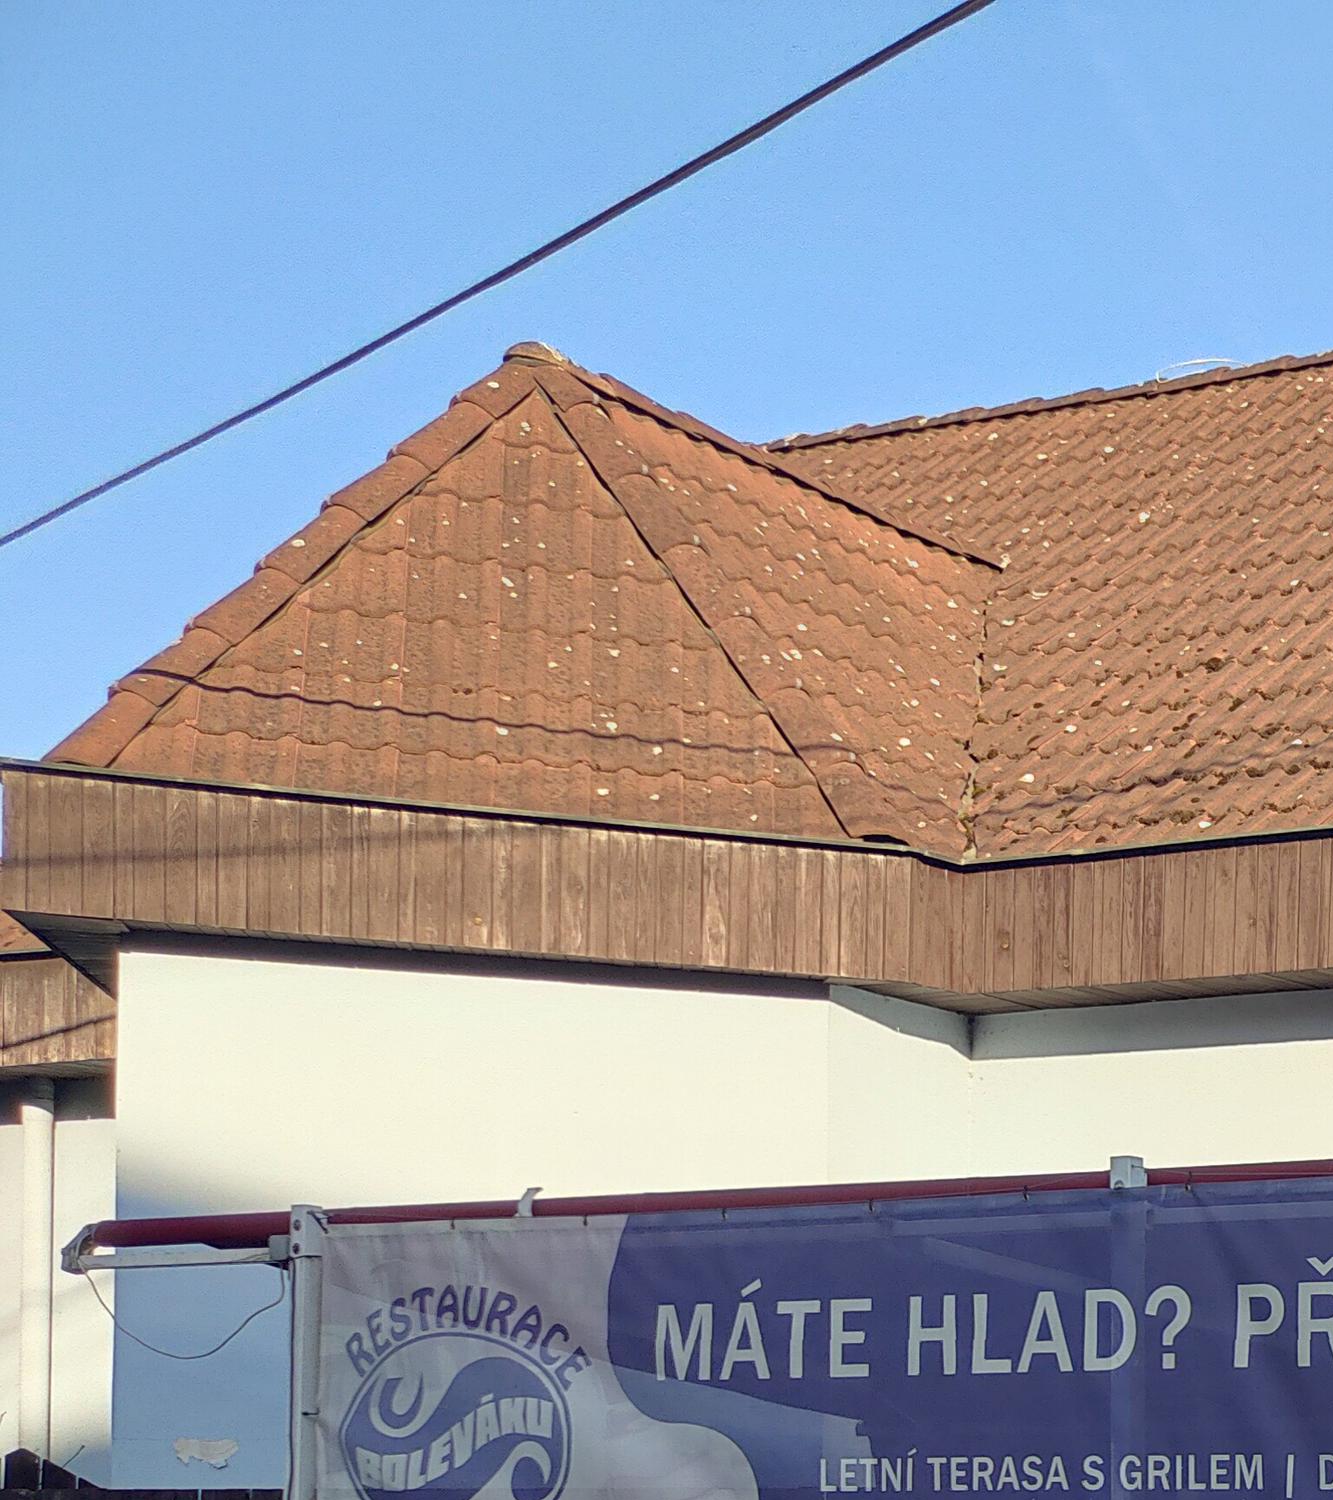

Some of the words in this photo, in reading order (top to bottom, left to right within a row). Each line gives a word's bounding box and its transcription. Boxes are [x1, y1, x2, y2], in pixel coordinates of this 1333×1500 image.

[345, 1284, 592, 1391] RESTAURACE
[655, 1277, 872, 1382] MÁTE
[906, 1285, 1193, 1377] HLAD?
[355, 1393, 554, 1492] BOLEVÁKU
[819, 1447, 918, 1493] LETNÍ
[927, 1454, 1069, 1492] TERASA
[1081, 1455, 1105, 1492] S
[1119, 1454, 1264, 1491] GRILEM
